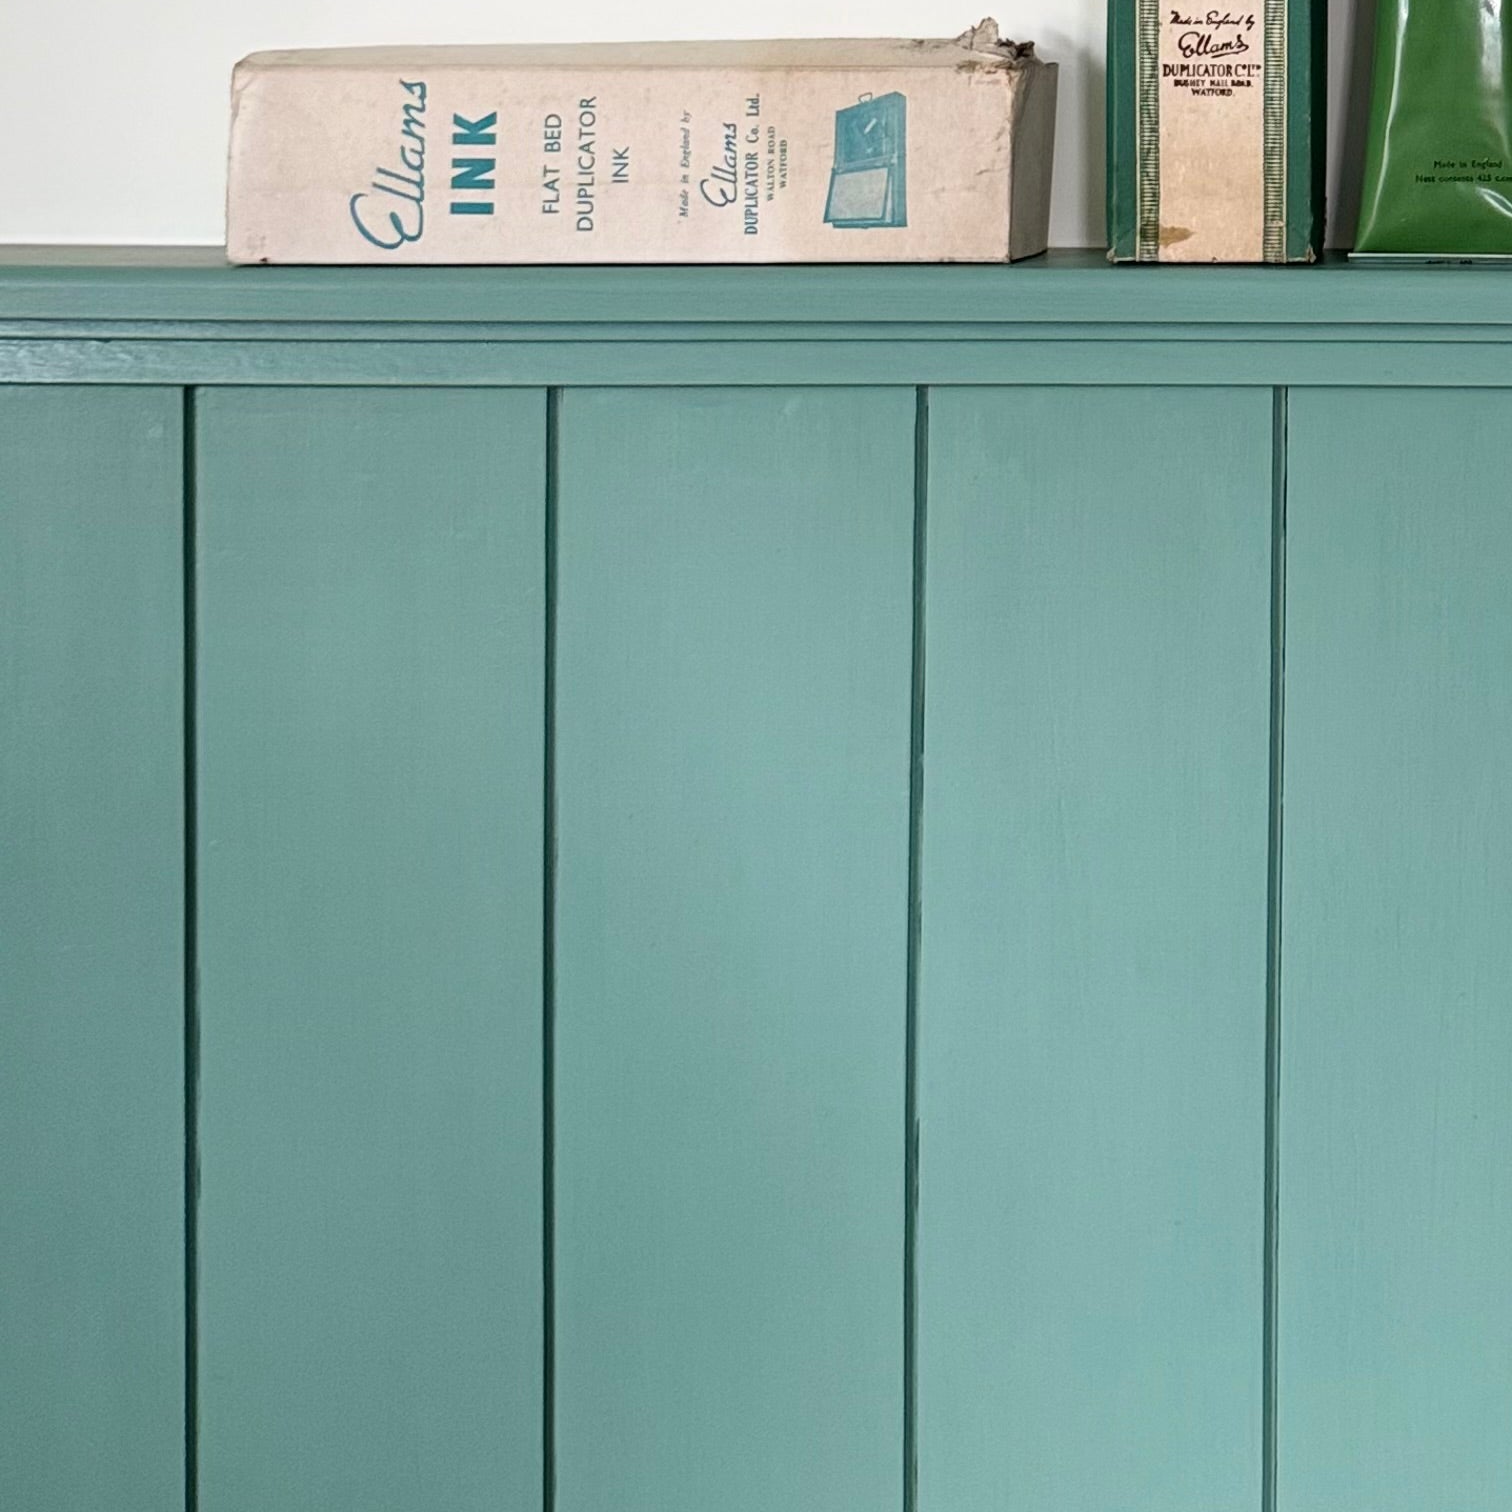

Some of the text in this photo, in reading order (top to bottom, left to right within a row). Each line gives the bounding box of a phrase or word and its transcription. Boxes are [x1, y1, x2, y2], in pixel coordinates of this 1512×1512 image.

[1169, 9, 1193, 26] Made
[1206, 10, 1245, 30] England
[1245, 14, 1256, 31] by
[1178, 31, 1250, 59] Ellams
[1162, 63, 1233, 78] DUPLICATOR
[349, 77, 428, 250] Ellams
[450, 111, 498, 215] INK
[542, 113, 562, 215] FLAT BED
[576, 96, 598, 232] DUPLICATOR
[611, 146, 630, 184] INK
[679, 109, 693, 218] Made in England by
[699, 122, 738, 208] Ellams
[744, 92, 761, 235] DUPLICATOR Co. Ltd.
[767, 125, 777, 202] WALTON ROAD
[779, 139, 789, 190] WATFORD
[1433, 159, 1504, 170] Made in England
